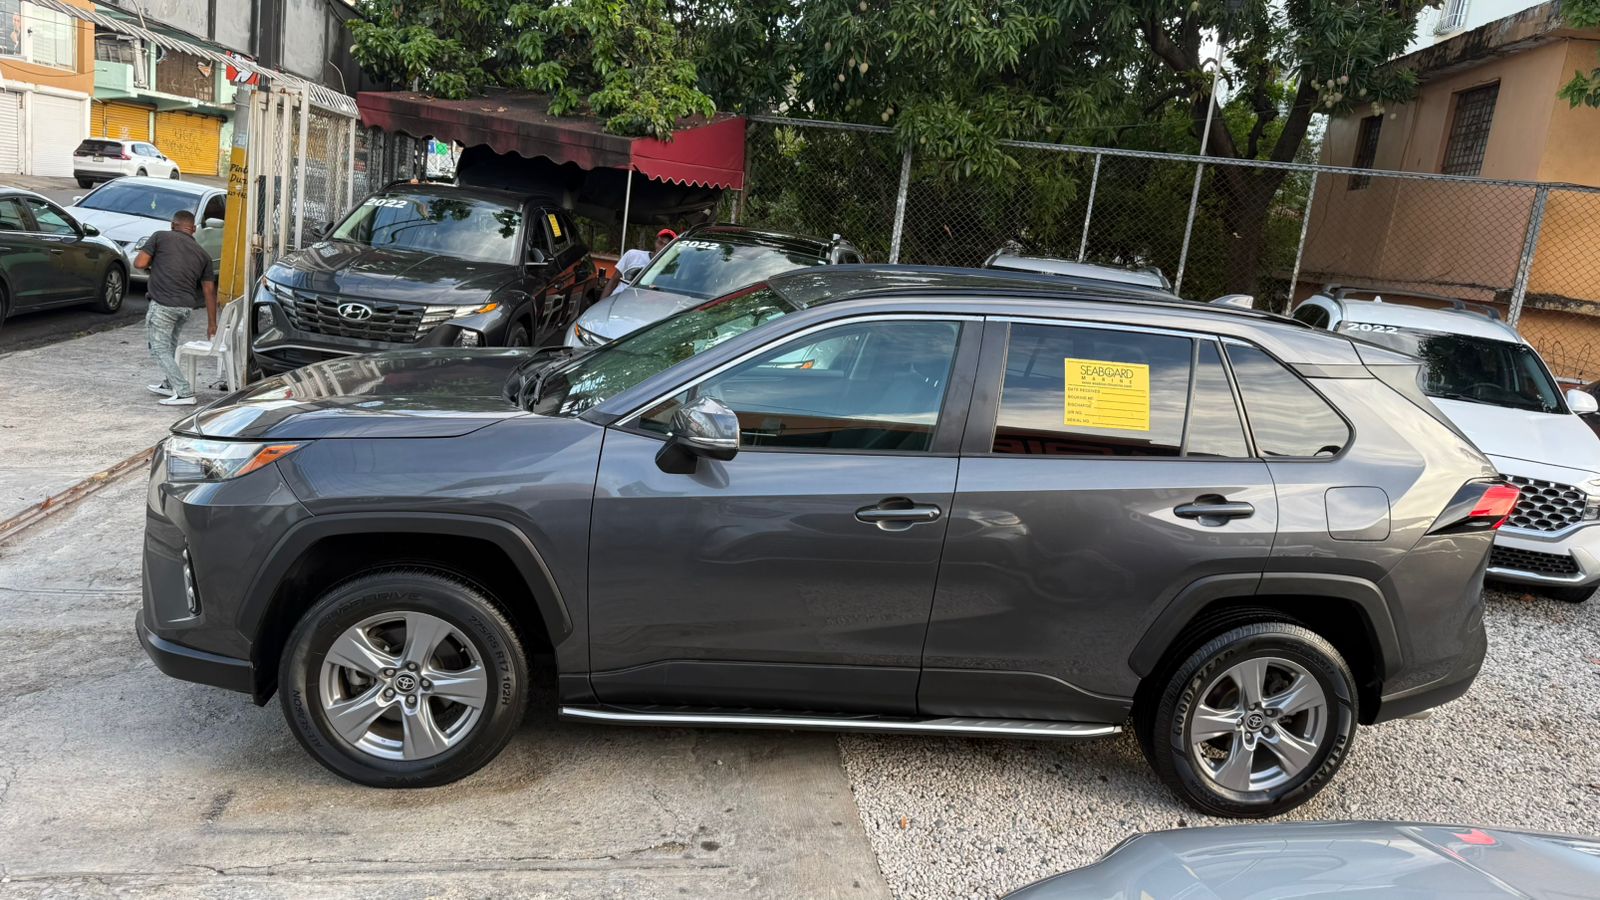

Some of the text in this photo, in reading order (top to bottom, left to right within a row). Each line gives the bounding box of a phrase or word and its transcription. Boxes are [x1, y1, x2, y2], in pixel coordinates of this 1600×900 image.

[363, 197, 408, 208] 2022
[678, 240, 720, 250] 2022
[1347, 322, 1398, 335] 2022
[1080, 365, 1134, 379] SEABOARD
[496, 651, 508, 672] R17
[501, 676, 511, 706] 102H
[1173, 650, 1234, 736] GOODYEAR
